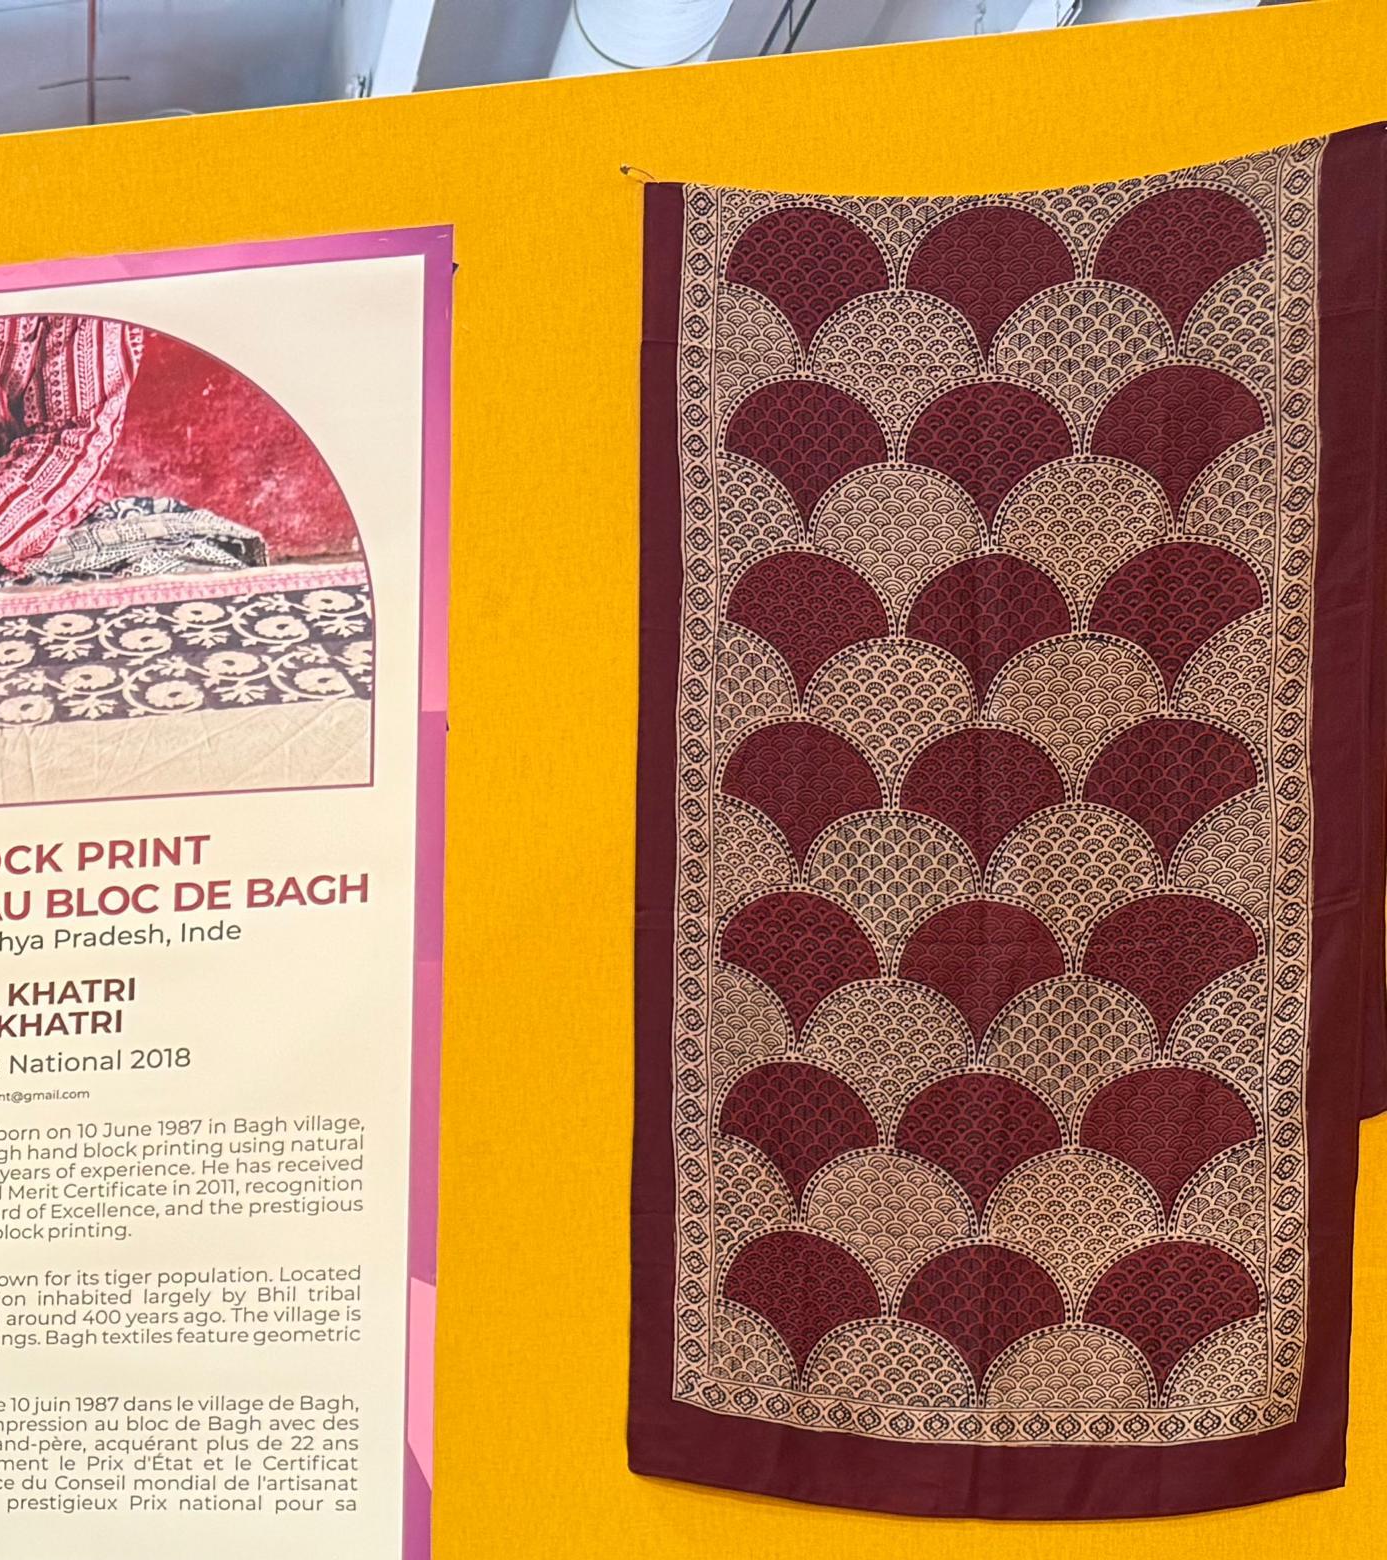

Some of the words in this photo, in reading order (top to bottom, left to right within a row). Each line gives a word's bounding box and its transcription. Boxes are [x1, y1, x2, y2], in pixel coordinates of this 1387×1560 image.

[77, 835, 210, 870] PRINT
[46, 883, 158, 918] BLOC
[173, 879, 231, 911] DE
[246, 873, 368, 907] BAGH
[54, 923, 170, 948] Pradesh,
[181, 920, 241, 942] Inde
[8, 977, 135, 1006] KHATRI
[9, 1049, 120, 1073] National
[130, 1047, 190, 1069] 2018
[46, 1127, 70, 1139] on
[78, 1122, 97, 1138] 10
[102, 1122, 151, 1138] June
[159, 1119, 201, 1135] 1987
[208, 1121, 225, 1134] in
[234, 1117, 286, 1136] Bagh
[293, 1116, 364, 1134] village,
[0, 1167, 50, 1184] years
[55, 1162, 75, 1178] of
[80, 1163, 194, 1180] experience.
[202, 1159, 229, 1174] He
[236, 1158, 271, 1173] has
[277, 1155, 362, 1172] received
[8, 1184, 58, 1200] Merit
[63, 1182, 167, 1198] Certificate
[173, 1183, 190, 1195] in
[195, 1179, 239, 1196] 2011,
[245, 1178, 362, 1196] recognition
[44, 1270, 71, 1286] for
[77, 1272, 99, 1285] its
[104, 1271, 152, 1288] tiger
[157, 1268, 273, 1287] population.
[279, 1265, 360, 1281] Located
[37, 1289, 131, 1305] inhabited
[143, 1288, 211, 1307] largely
[222, 1288, 246, 1306] by
[257, 1287, 295, 1302] Bhil
[308, 1286, 360, 1301] tribal
[11, 1397, 29, 1412] 10
[32, 1400, 70, 1415] juin
[76, 1396, 117, 1411] 1987
[123, 1396, 172, 1411] dans
[177, 1396, 193, 1411] le
[197, 1396, 263, 1414] village
[268, 1395, 294, 1410] de
[300, 1395, 358, 1414] Bagh,
[21, 1474, 46, 1490] du
[54, 1475, 125, 1490] Conseil
[133, 1474, 215, 1490] mondial
[223, 1475, 249, 1490] de
[257, 1475, 357, 1490] l'artisanat
